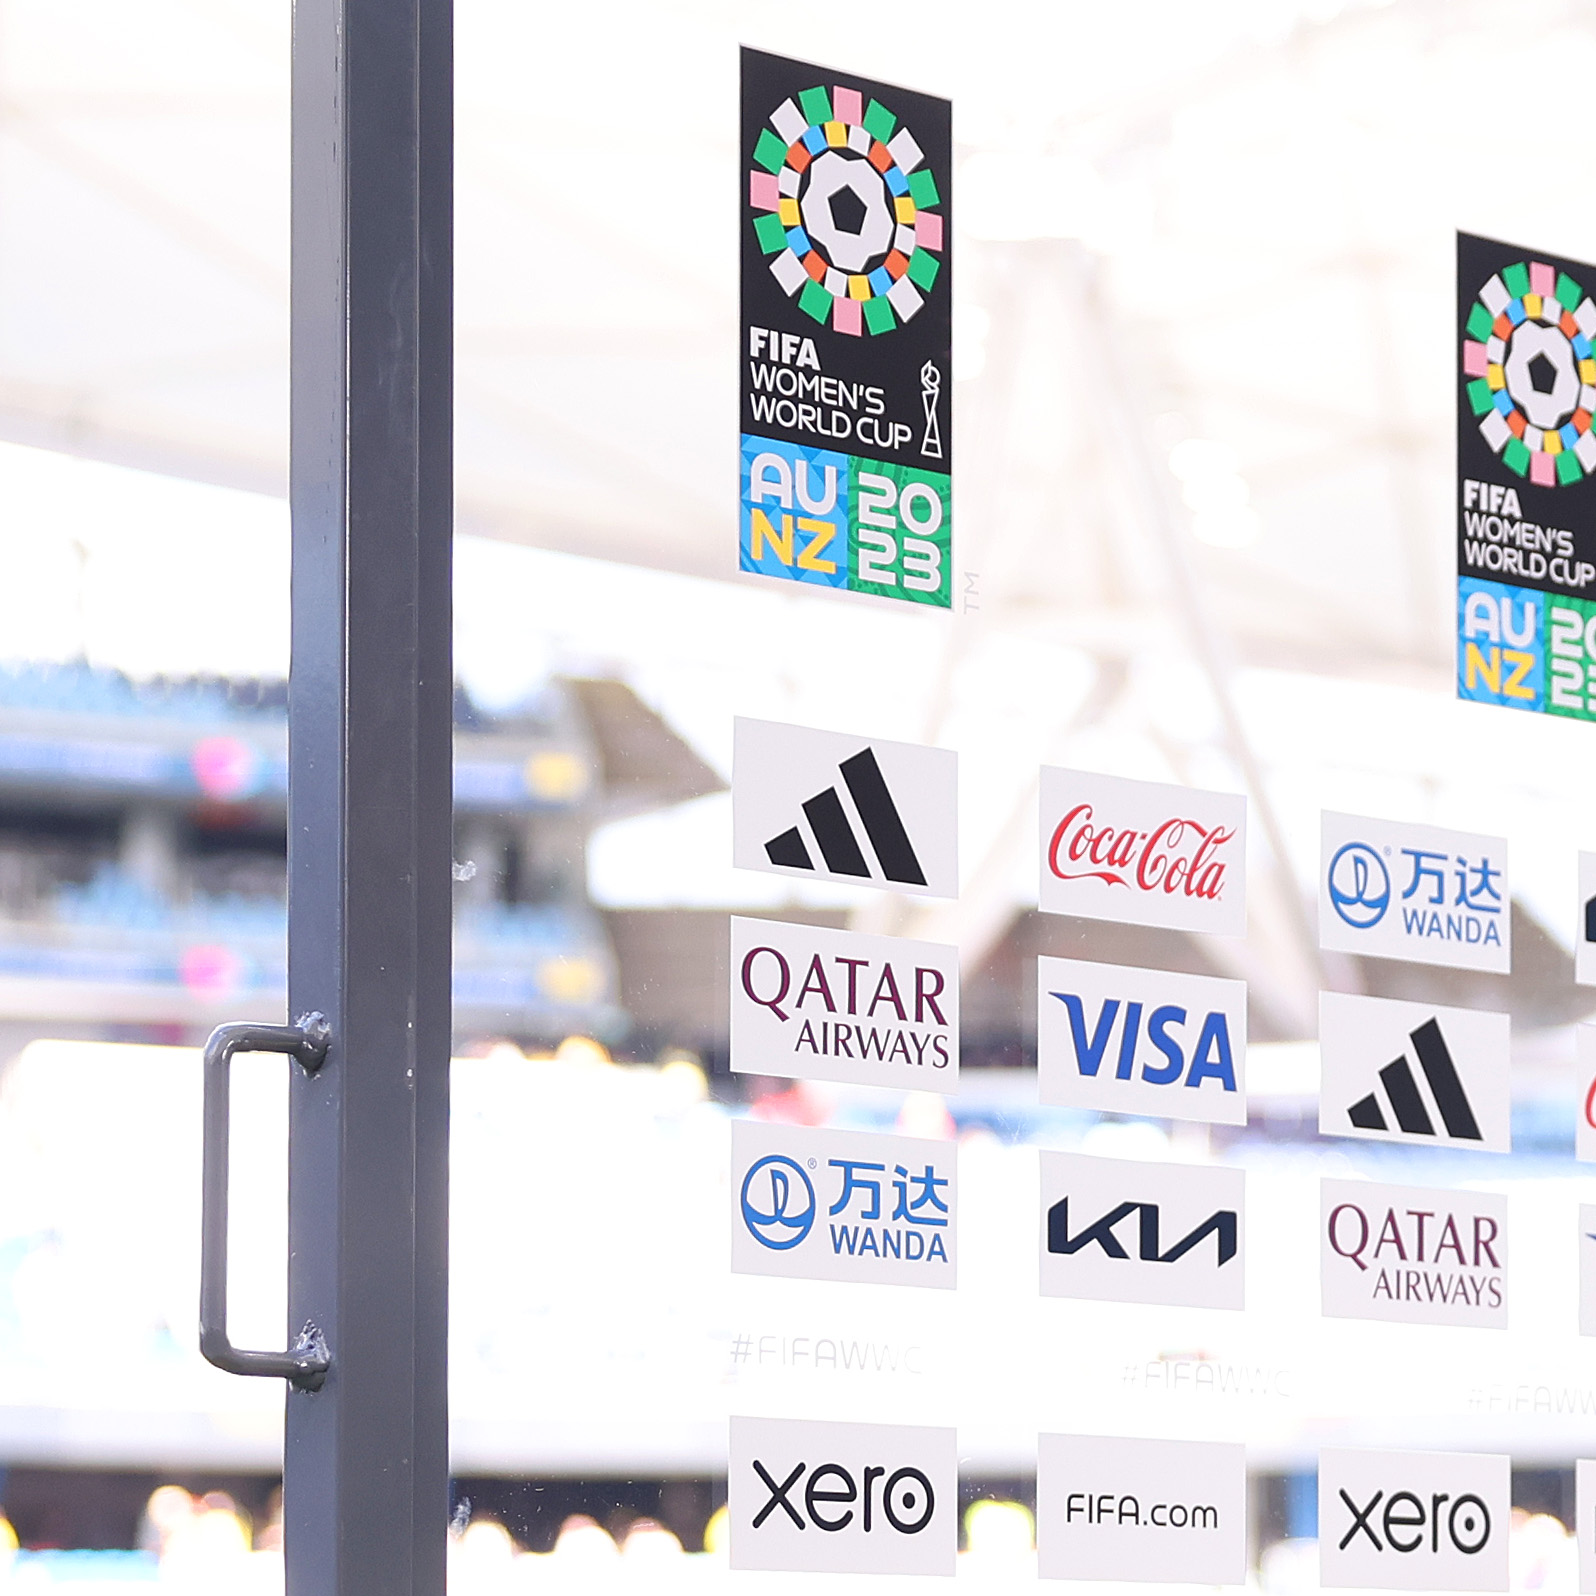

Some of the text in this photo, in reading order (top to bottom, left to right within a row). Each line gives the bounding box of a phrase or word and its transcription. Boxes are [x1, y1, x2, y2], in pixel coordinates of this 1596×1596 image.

[749, 326, 821, 371] FIFA
[749, 361, 886, 416] WOMEN'S
[749, 392, 912, 451] WORLD CUP
[749, 452, 838, 516] AU
[857, 470, 943, 537] 20
[1463, 479, 1523, 519] FIFA
[749, 508, 838, 575] NZ
[857, 527, 942, 593] 23
[1464, 510, 1574, 558] WOMEN'S
[1464, 538, 1596, 588] WORLD CUP
[1464, 591, 1537, 648] AU
[1465, 641, 1536, 700] NZ
[1400, 847, 1502, 914] 万达
[1401, 907, 1502, 947] WANDA
[741, 946, 949, 1027] QATAR
[794, 1018, 950, 1070] AIRWAYS
[1047, 990, 1238, 1093] VISA
[827, 1158, 950, 1227] 万达
[829, 1223, 949, 1264] WANDA
[1327, 1203, 1502, 1272] QATAR
[1372, 1268, 1502, 1309] AIRWAYS
[751, 1459, 935, 1535] xero
[1066, 1492, 1219, 1529] FIFA.com
[1338, 1488, 1491, 1555] xero
